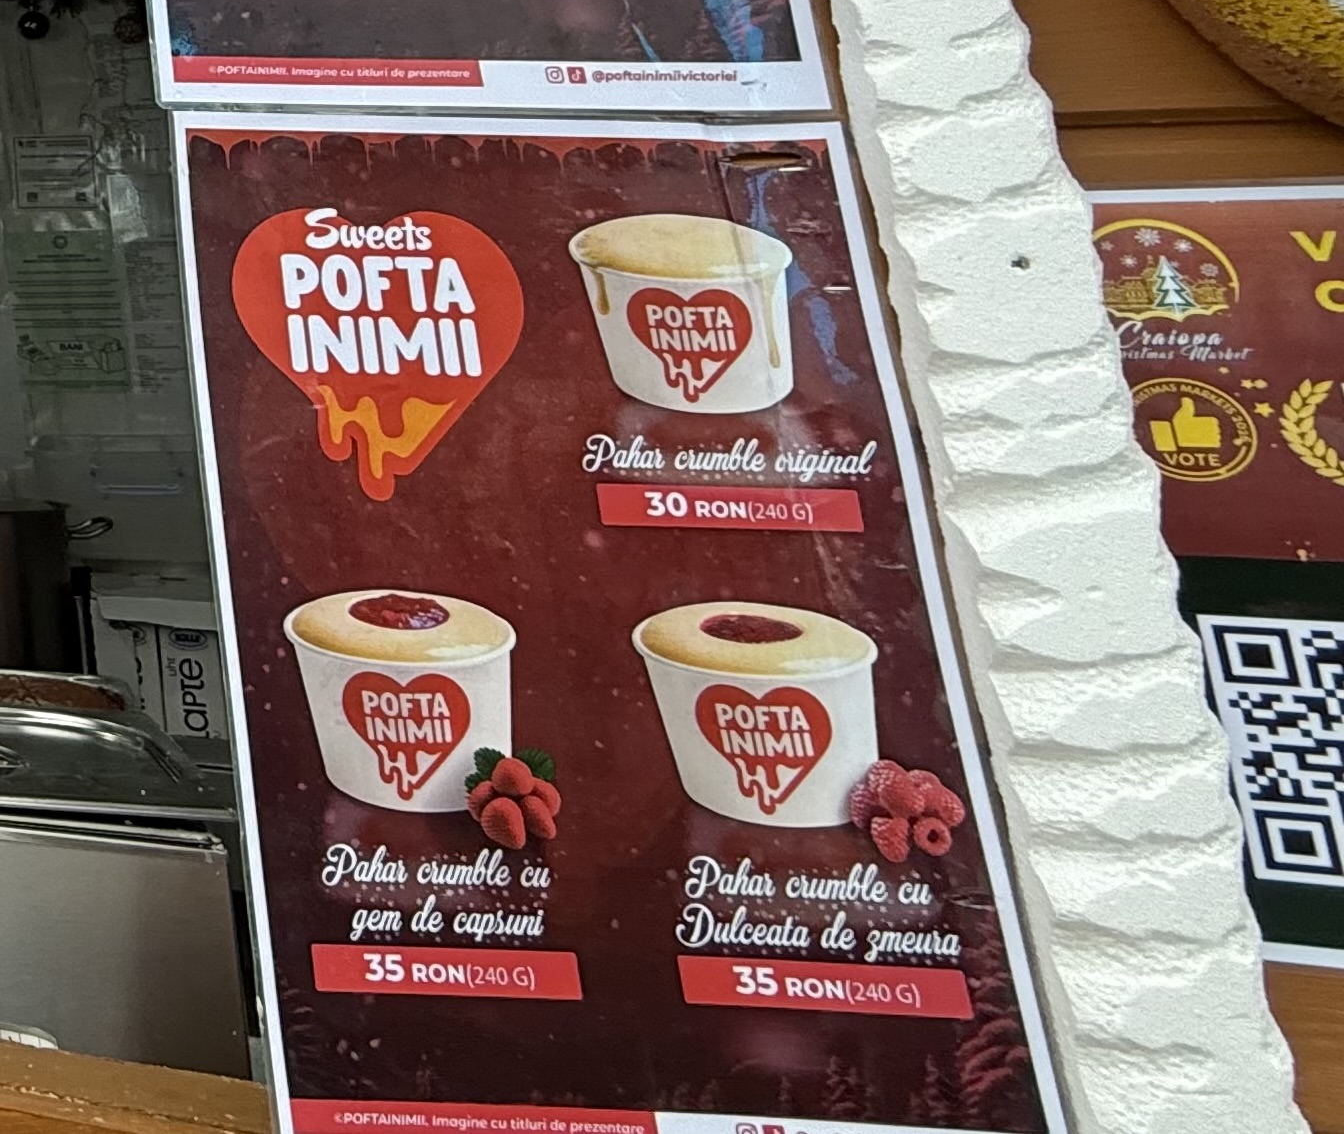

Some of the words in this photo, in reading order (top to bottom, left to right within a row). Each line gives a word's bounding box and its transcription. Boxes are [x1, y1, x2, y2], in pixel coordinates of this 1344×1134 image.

[292, 67, 337, 78] Imagine
[341, 69, 353, 77] cu
[357, 67, 388, 77] titluri
[391, 69, 404, 77] de
[408, 69, 470, 79] prezentare
[304, 208, 432, 251] Sweets
[280, 253, 476, 314] POFTA
[645, 304, 734, 328] POFTA
[287, 314, 482, 377] INIMII
[649, 328, 737, 352] INIMII
[582, 434, 665, 472] Pahar
[674, 437, 766, 473] crumble
[775, 440, 878, 482] original
[1163, 453, 1221, 466] VOTE
[644, 492, 688, 516] 30
[362, 690, 451, 717] POFTA
[714, 703, 811, 731] POFTA
[366, 717, 452, 744] INIMII
[721, 729, 814, 757] INIMII
[321, 843, 408, 886] Pahar
[416, 848, 511, 887] crumble
[520, 865, 551, 888] cu
[685, 856, 776, 898] Pahar
[785, 863, 888, 902] crumble
[898, 882, 932, 905] cu
[350, 909, 402, 941] gem
[410, 894, 444, 934] de
[453, 909, 545, 942] capsuni
[675, 903, 810, 948] Dulceata
[821, 911, 856, 950] de
[863, 929, 961, 962] zmeura
[363, 953, 405, 982] 35
[732, 966, 778, 996] 35
[432, 1116, 488, 1129] Imagine
[491, 1118, 507, 1129] cu
[510, 1118, 547, 1130] titluri
[550, 1119, 566, 1132] de
[570, 1121, 644, 1134] prezentare
